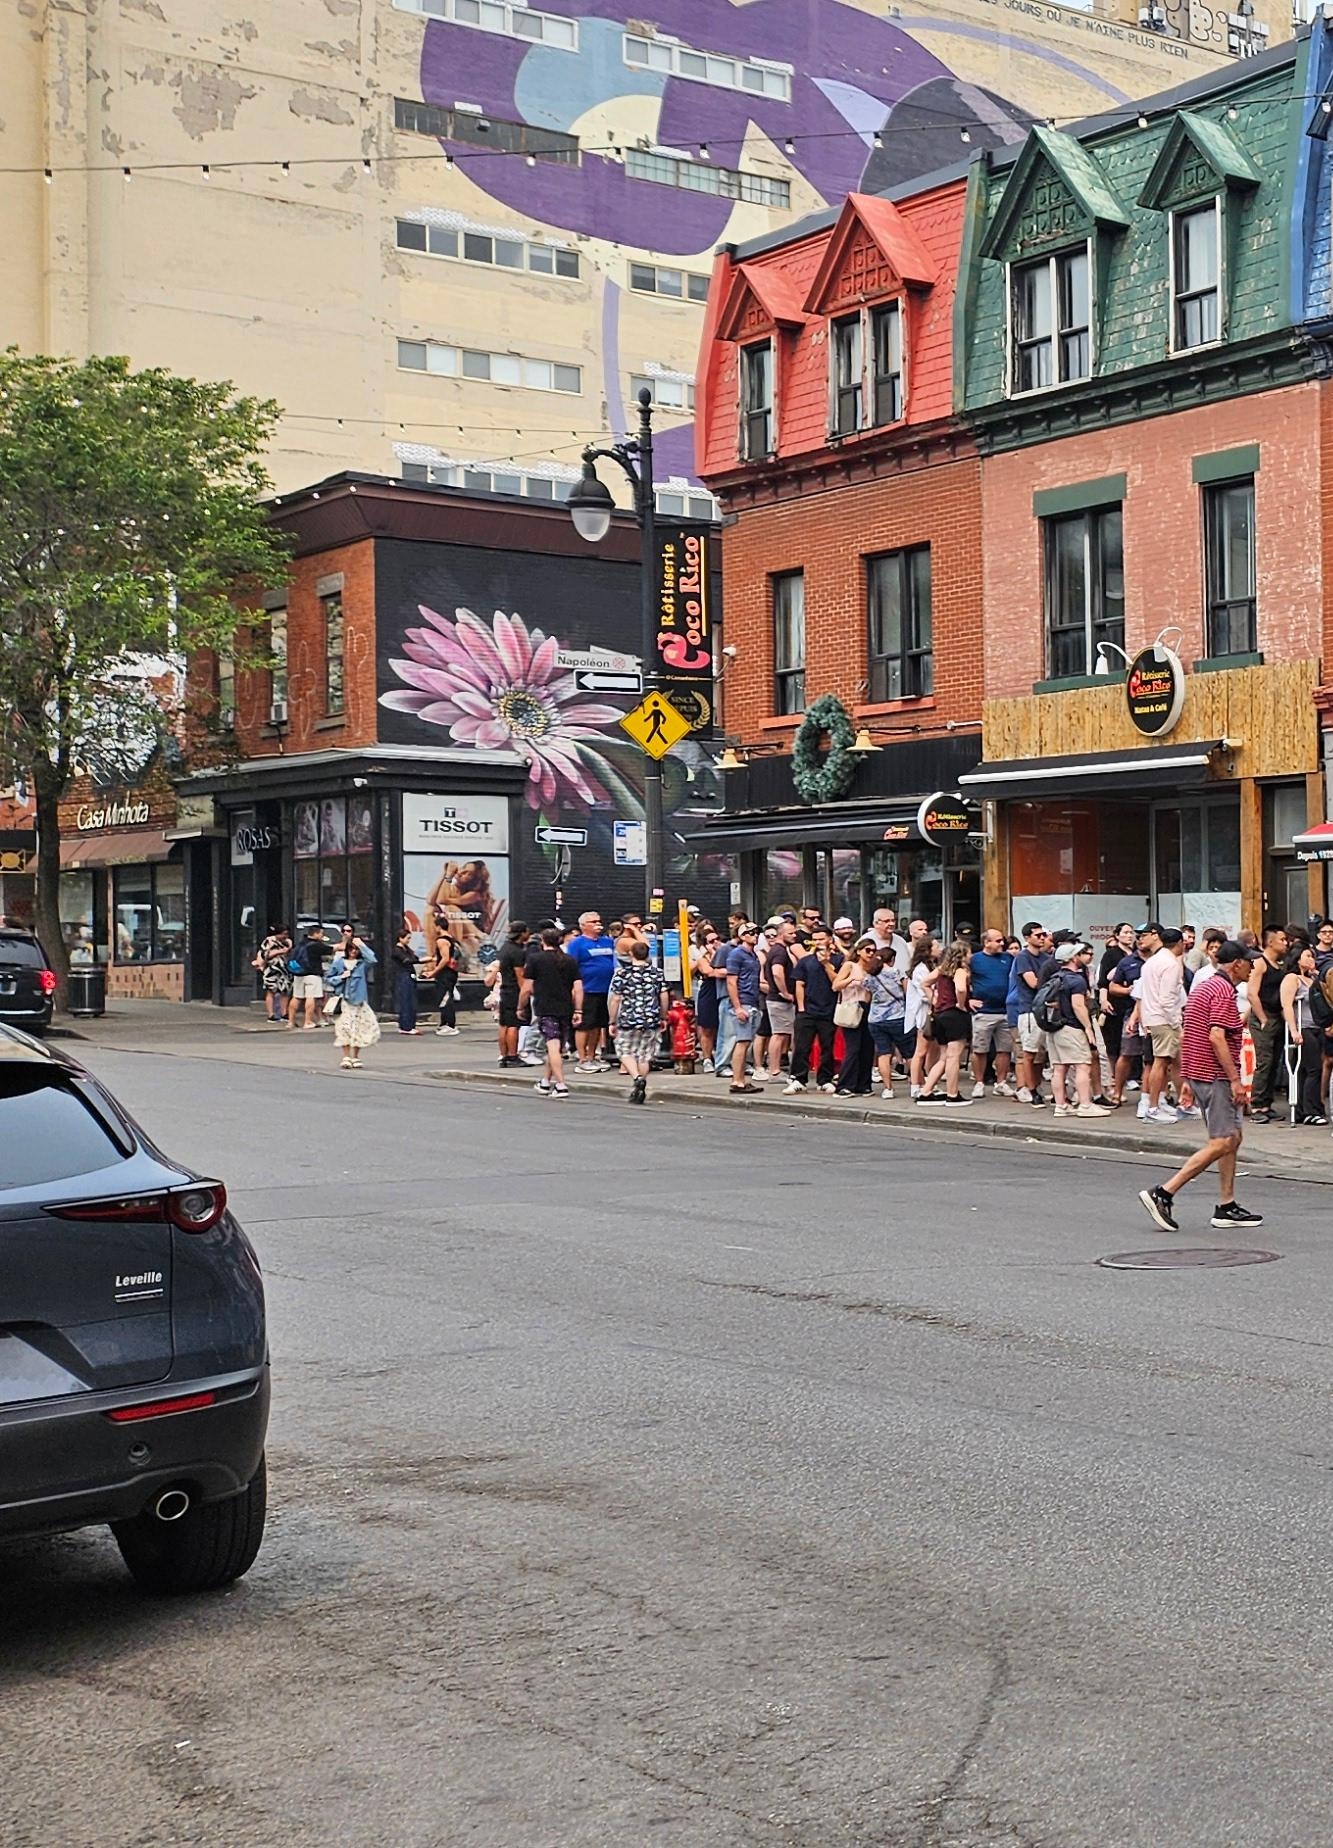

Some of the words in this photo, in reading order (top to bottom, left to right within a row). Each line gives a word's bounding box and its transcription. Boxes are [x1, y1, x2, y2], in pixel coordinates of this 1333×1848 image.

[1128, 32, 1156, 49] PLUS
[679, 536, 700, 593] Rico
[660, 543, 675, 627] Rôtisserie
[557, 655, 610, 668] Napoléon
[77, 805, 105, 830] Casa
[419, 819, 493, 833] TISSOT
